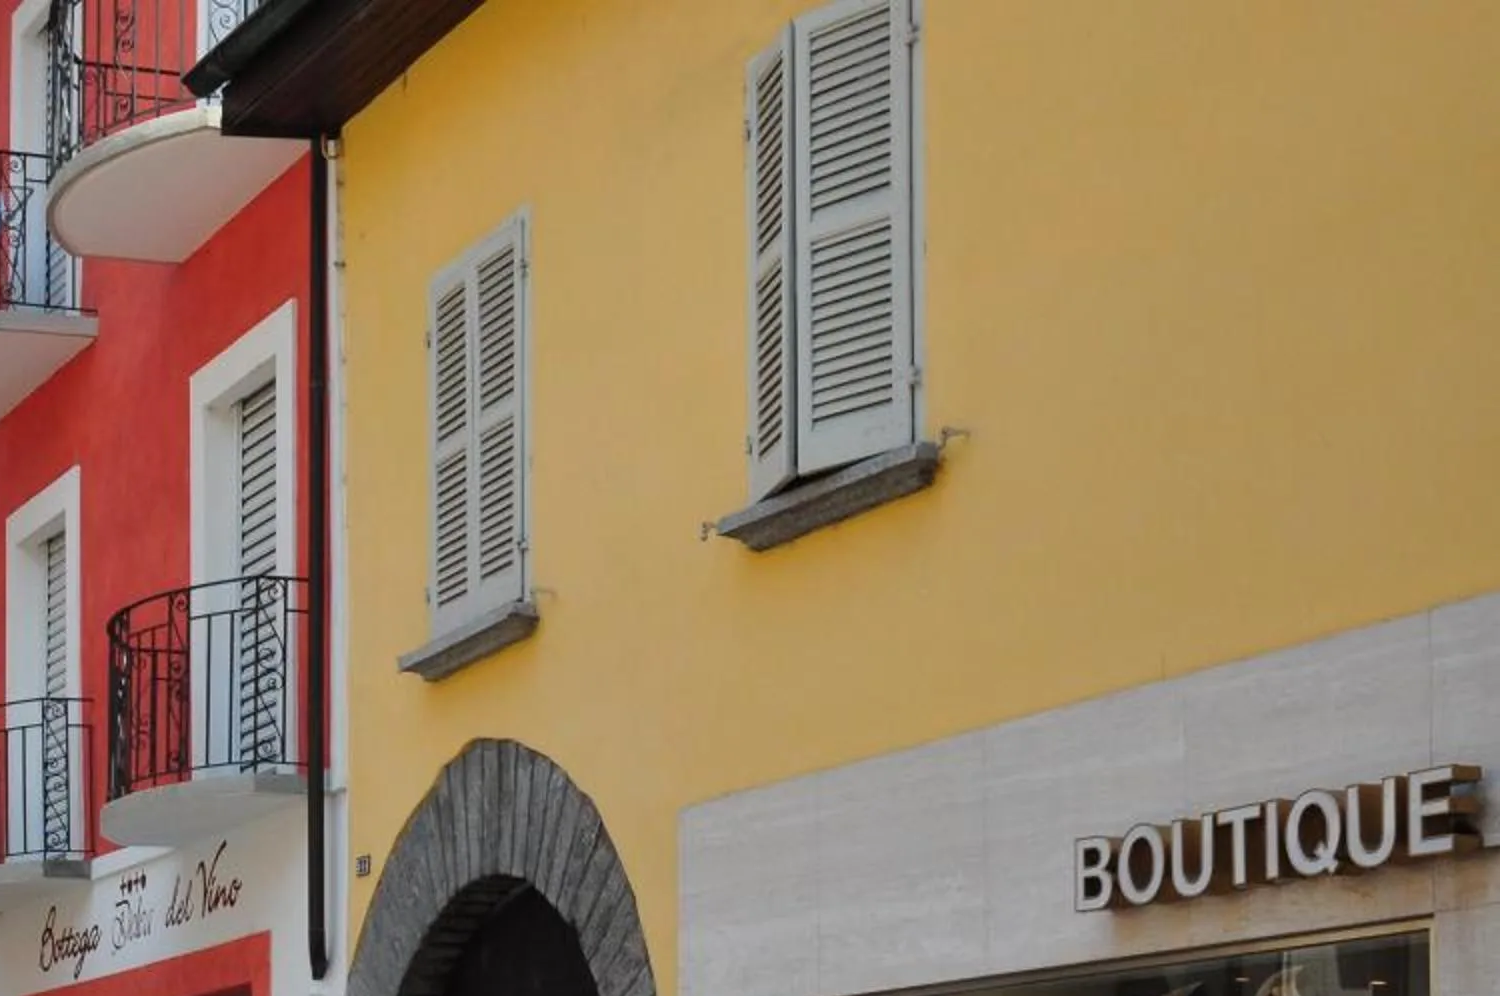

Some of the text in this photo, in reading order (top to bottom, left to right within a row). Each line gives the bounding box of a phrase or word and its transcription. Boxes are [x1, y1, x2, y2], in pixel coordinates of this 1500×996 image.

[40, 906, 101, 979] Bottega
[164, 873, 194, 928] del
[196, 840, 242, 919] Vino
[1074, 765, 1466, 913] BOUTIQUE
